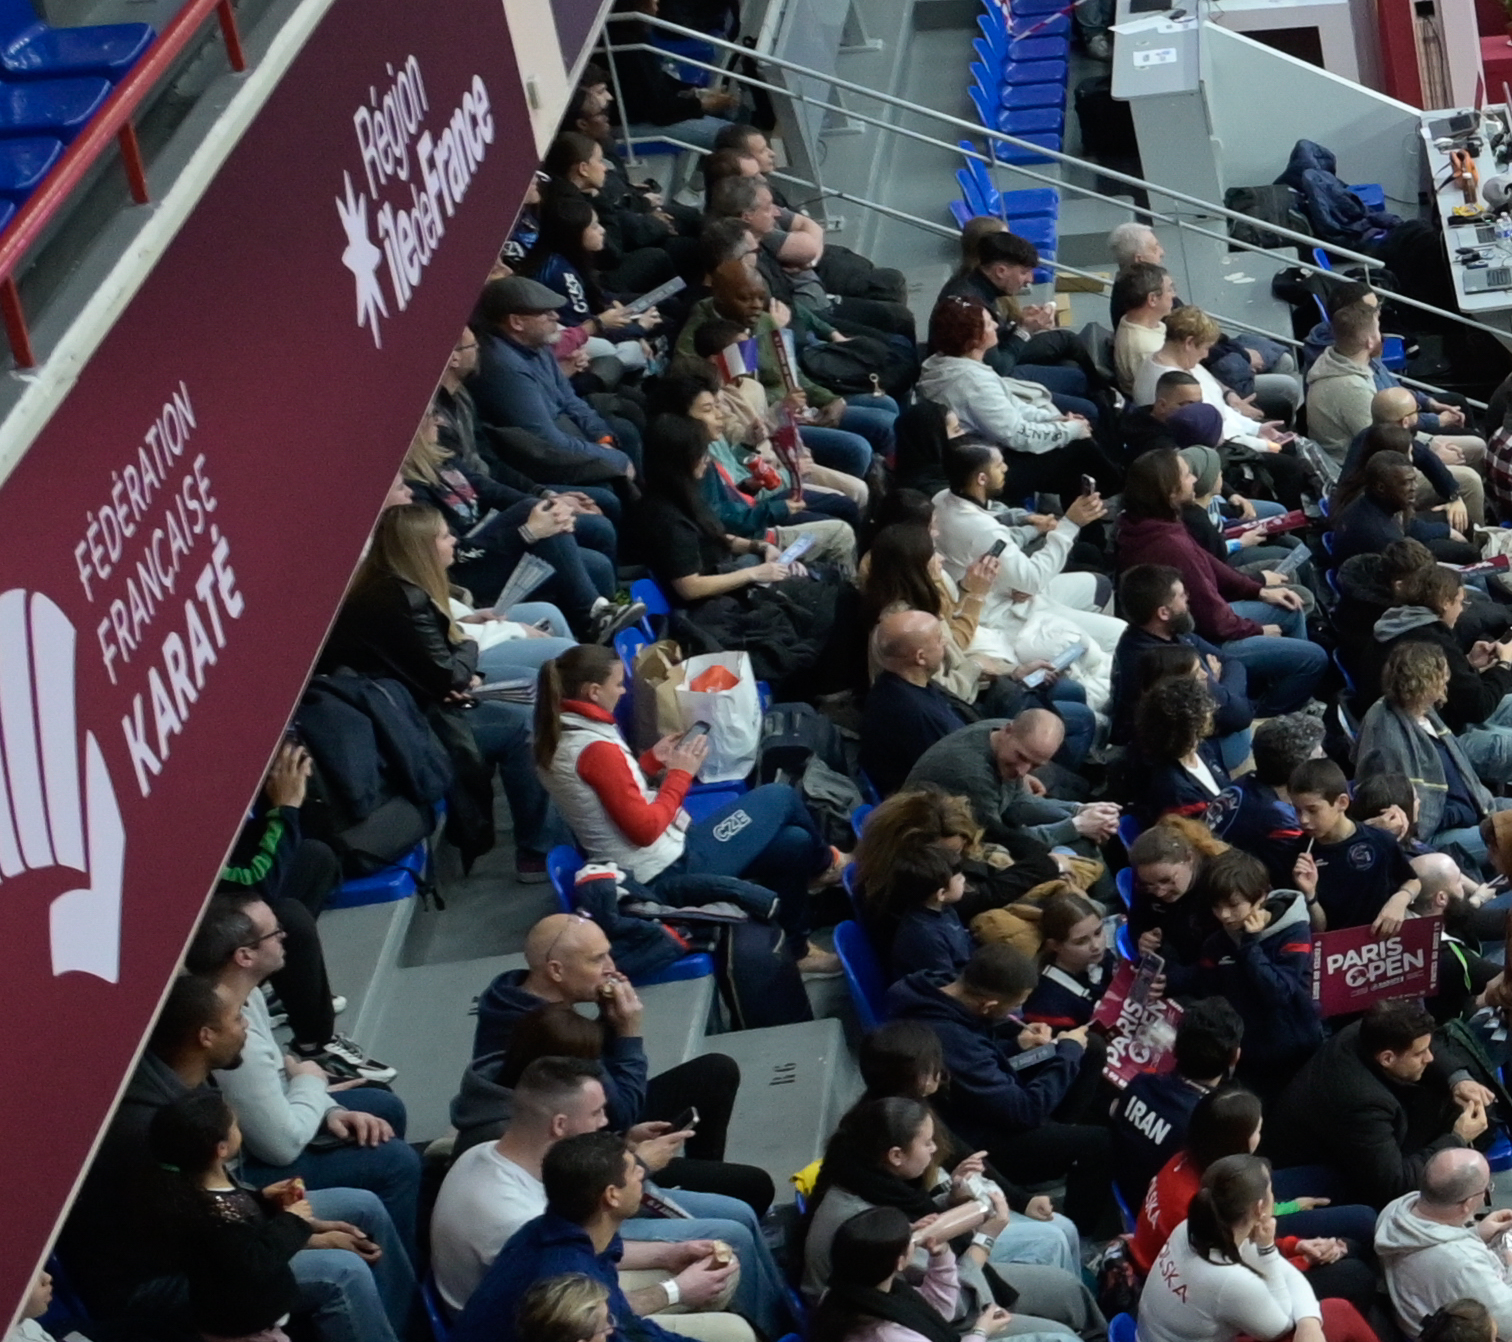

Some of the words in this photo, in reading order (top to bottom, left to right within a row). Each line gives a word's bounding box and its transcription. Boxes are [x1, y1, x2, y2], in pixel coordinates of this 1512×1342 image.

[354, 55, 429, 198] Région
[74, 380, 197, 601] FÉDÉRATION
[98, 453, 216, 684] FRANÇAISE
[119, 523, 245, 797] KARATÉ
[1327, 937, 1402, 975] PARIS
[1344, 949, 1425, 987] OPEN
[1105, 998, 1144, 1070] PARIS
[1124, 1095, 1172, 1146] IRAN
